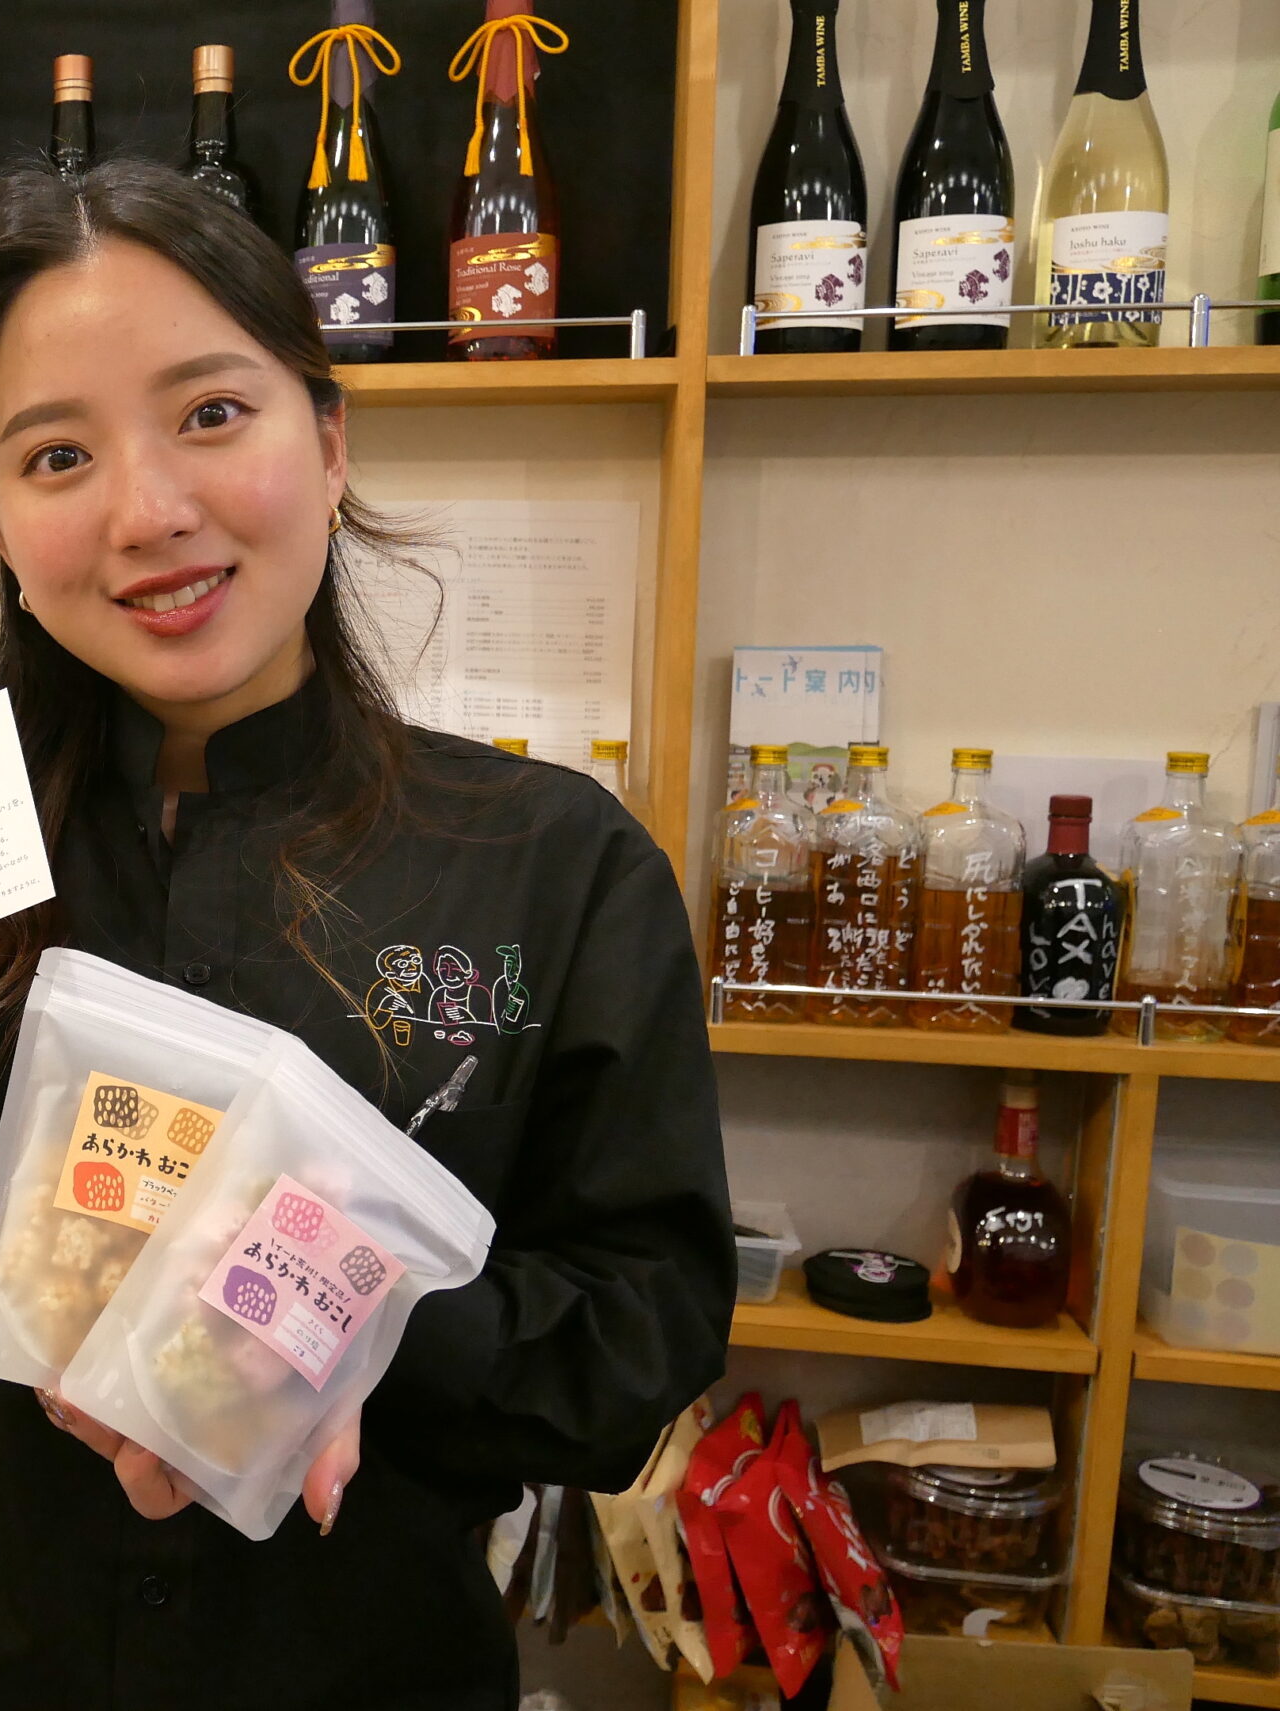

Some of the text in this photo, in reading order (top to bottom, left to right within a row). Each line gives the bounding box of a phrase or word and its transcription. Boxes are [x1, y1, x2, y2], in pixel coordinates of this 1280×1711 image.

[816, 15, 826, 87] TAMBA WINE
[959, 1, 972, 73] TAMBA WINE
[1120, 31, 1130, 72] TAMBA
[913, 247, 958, 260] Saperavi
[1056, 878, 1103, 965] TAX
